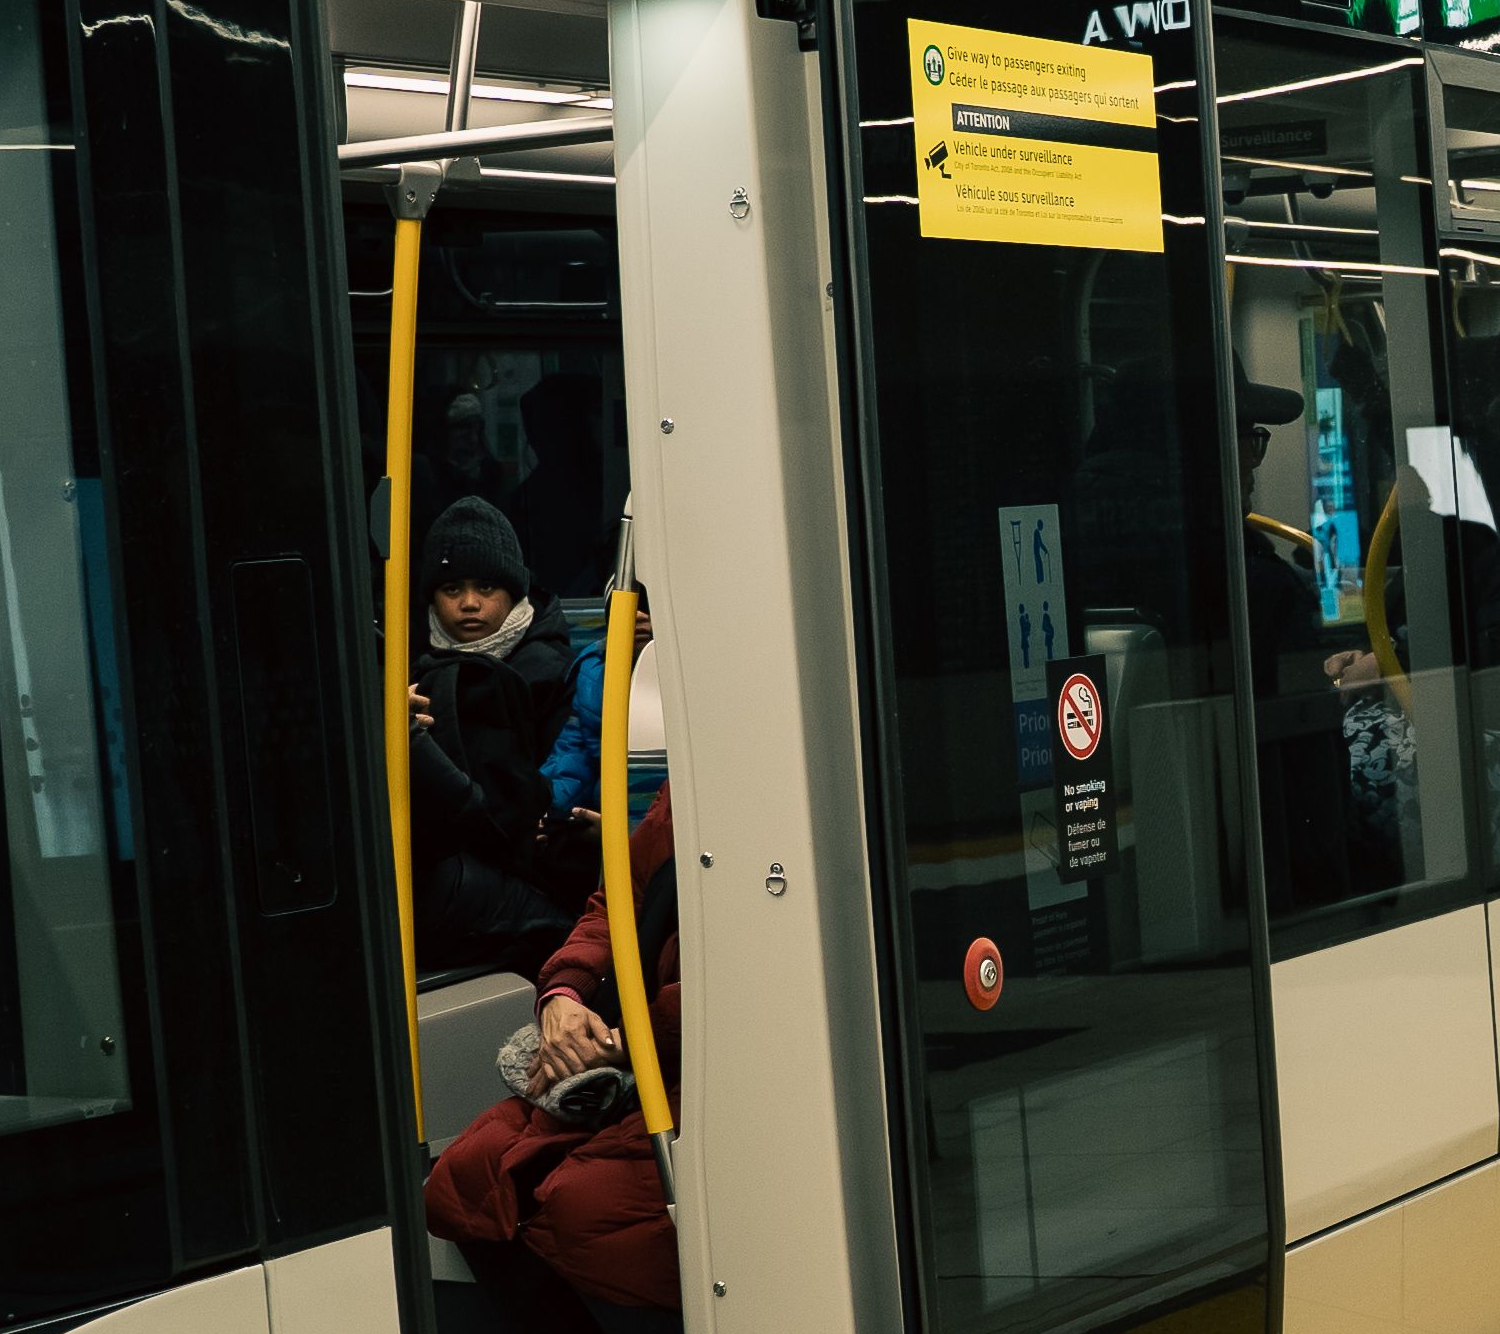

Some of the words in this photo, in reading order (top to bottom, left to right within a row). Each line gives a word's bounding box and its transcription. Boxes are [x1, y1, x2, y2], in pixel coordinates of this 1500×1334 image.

[947, 46, 968, 63] Give
[971, 50, 989, 68] way
[991, 52, 1001, 66] to
[1004, 57, 1054, 75] passengers
[1057, 62, 1086, 82] exiting
[949, 72, 977, 89] Céder
[980, 75, 988, 90] le
[991, 79, 1028, 97] passage
[1031, 85, 1046, 97] aux
[1049, 87, 1092, 108] passagers
[1094, 91, 1107, 108] qui
[1109, 94, 1139, 110] sortent
[957, 110, 1010, 131] ATTENTION
[1221, 130, 1313, 147] Surveillance
[954, 140, 987, 158] Vehicle
[990, 145, 1016, 161] under
[1019, 148, 1073, 166] surveillance
[956, 184, 995, 201] Véhicule
[998, 191, 1019, 204] sous
[1021, 191, 1075, 207] surveillance
[1064, 784, 1075, 796] No
[1076, 779, 1106, 793] smoking
[1065, 802, 1073, 812] or
[1075, 797, 1099, 812] vaping
[1067, 820, 1096, 837] Défense
[1097, 819, 1107, 829] de
[1068, 839, 1089, 852] fumer
[1091, 837, 1100, 848] ou
[1069, 857, 1078, 868] de
[1080, 851, 1108, 867] vapoter
